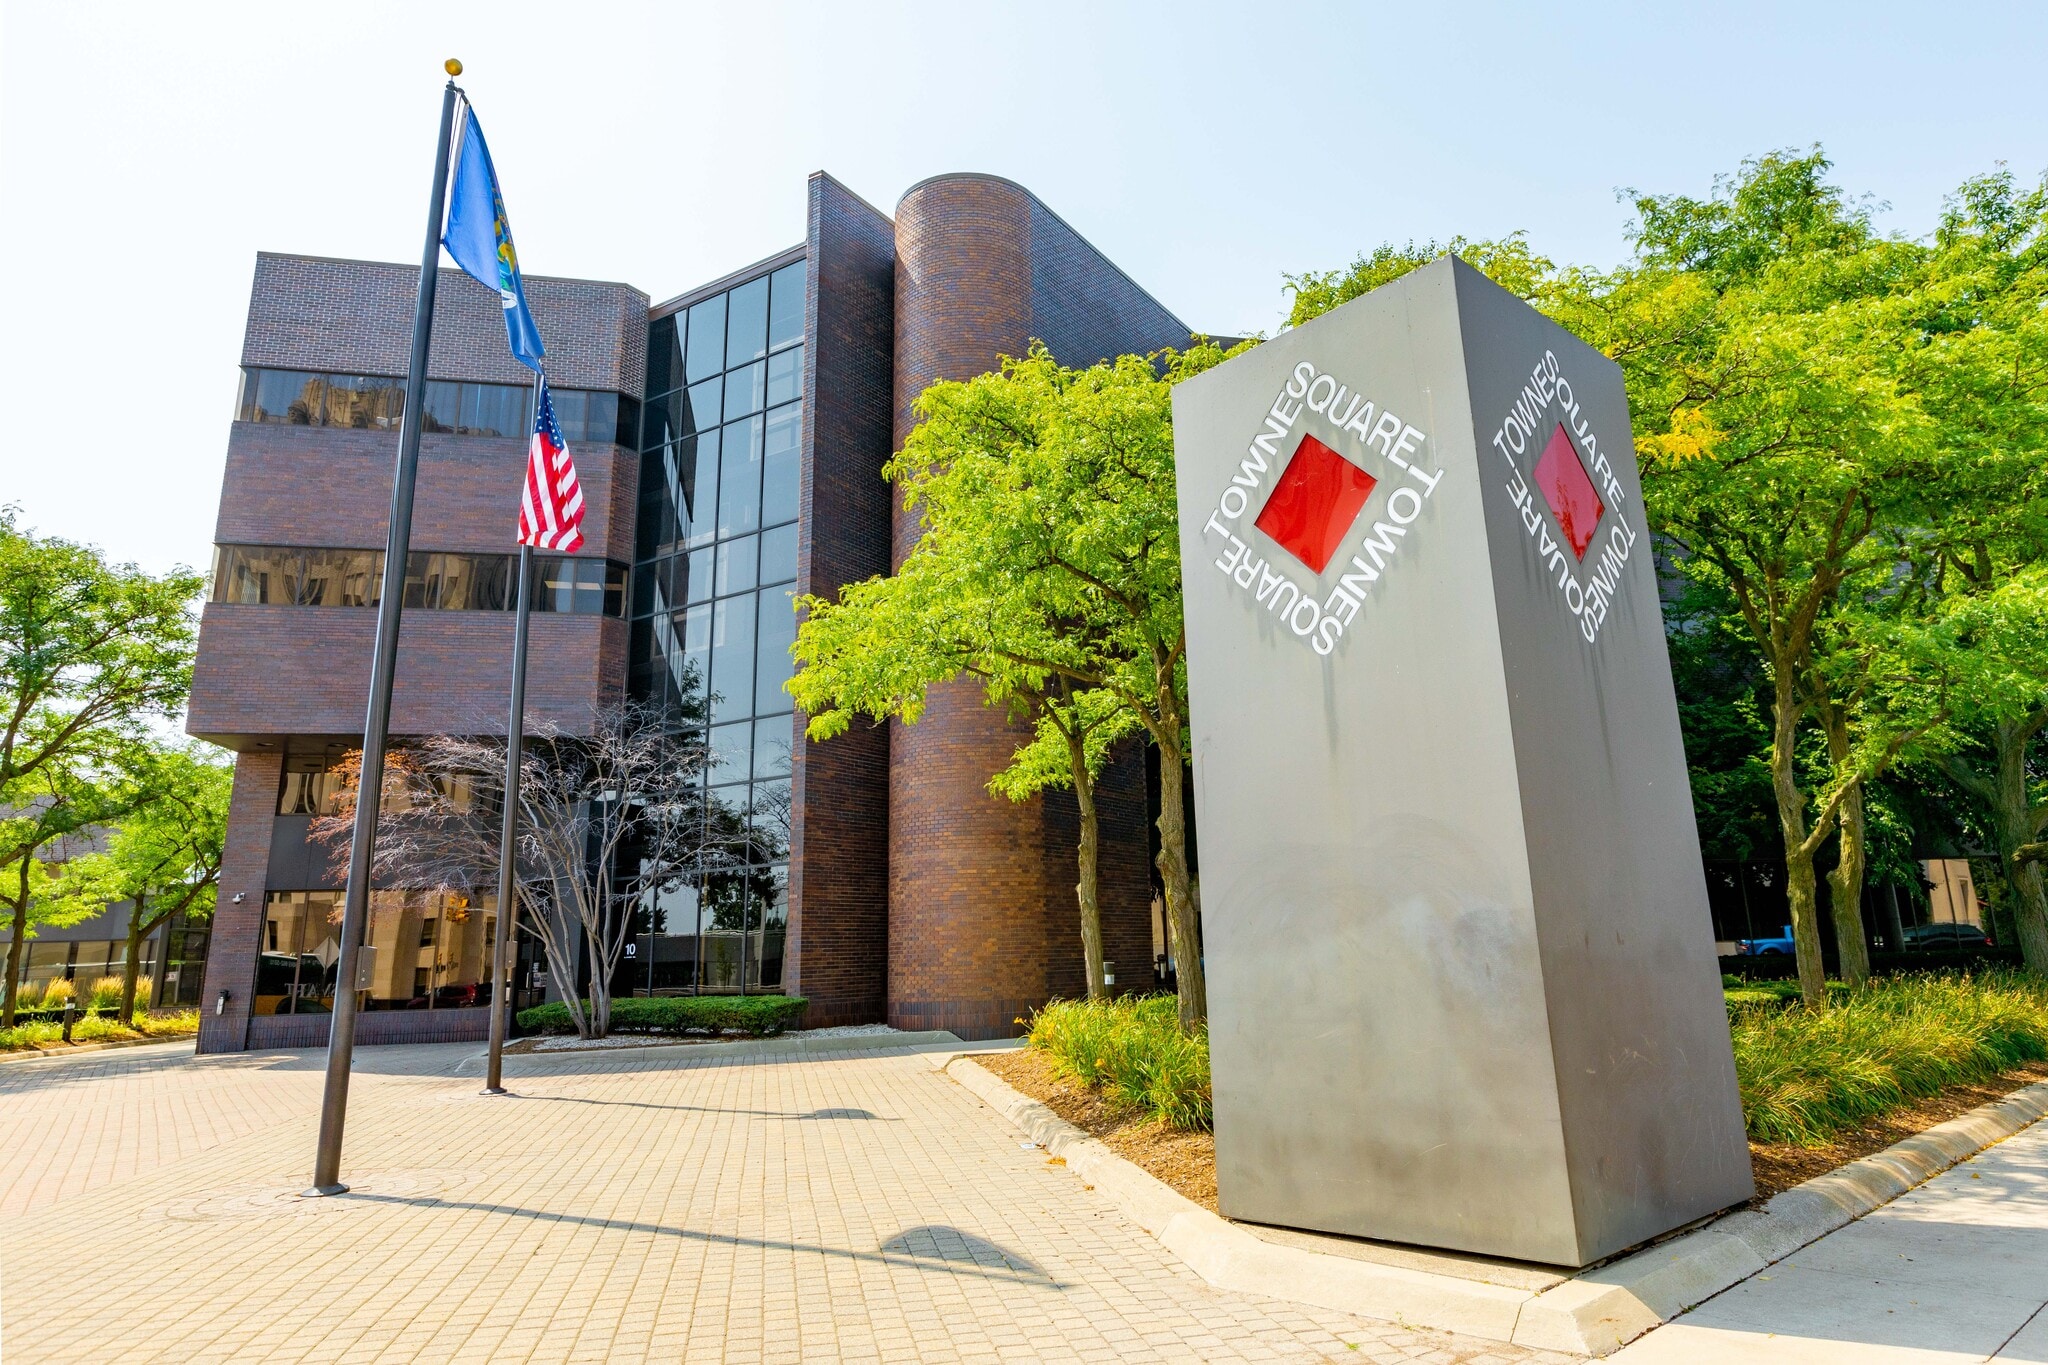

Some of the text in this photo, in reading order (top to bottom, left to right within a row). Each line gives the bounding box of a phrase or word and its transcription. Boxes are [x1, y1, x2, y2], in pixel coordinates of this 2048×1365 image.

[1202, 361, 1426, 540] TOWNE SQUARE
[1493, 350, 1625, 513] TOWNE SQUARE
[1214, 464, 1444, 656] TOWNE SQUARE
[1505, 468, 1637, 644] TOWNE SQUARE
[625, 943, 636, 956] 10
